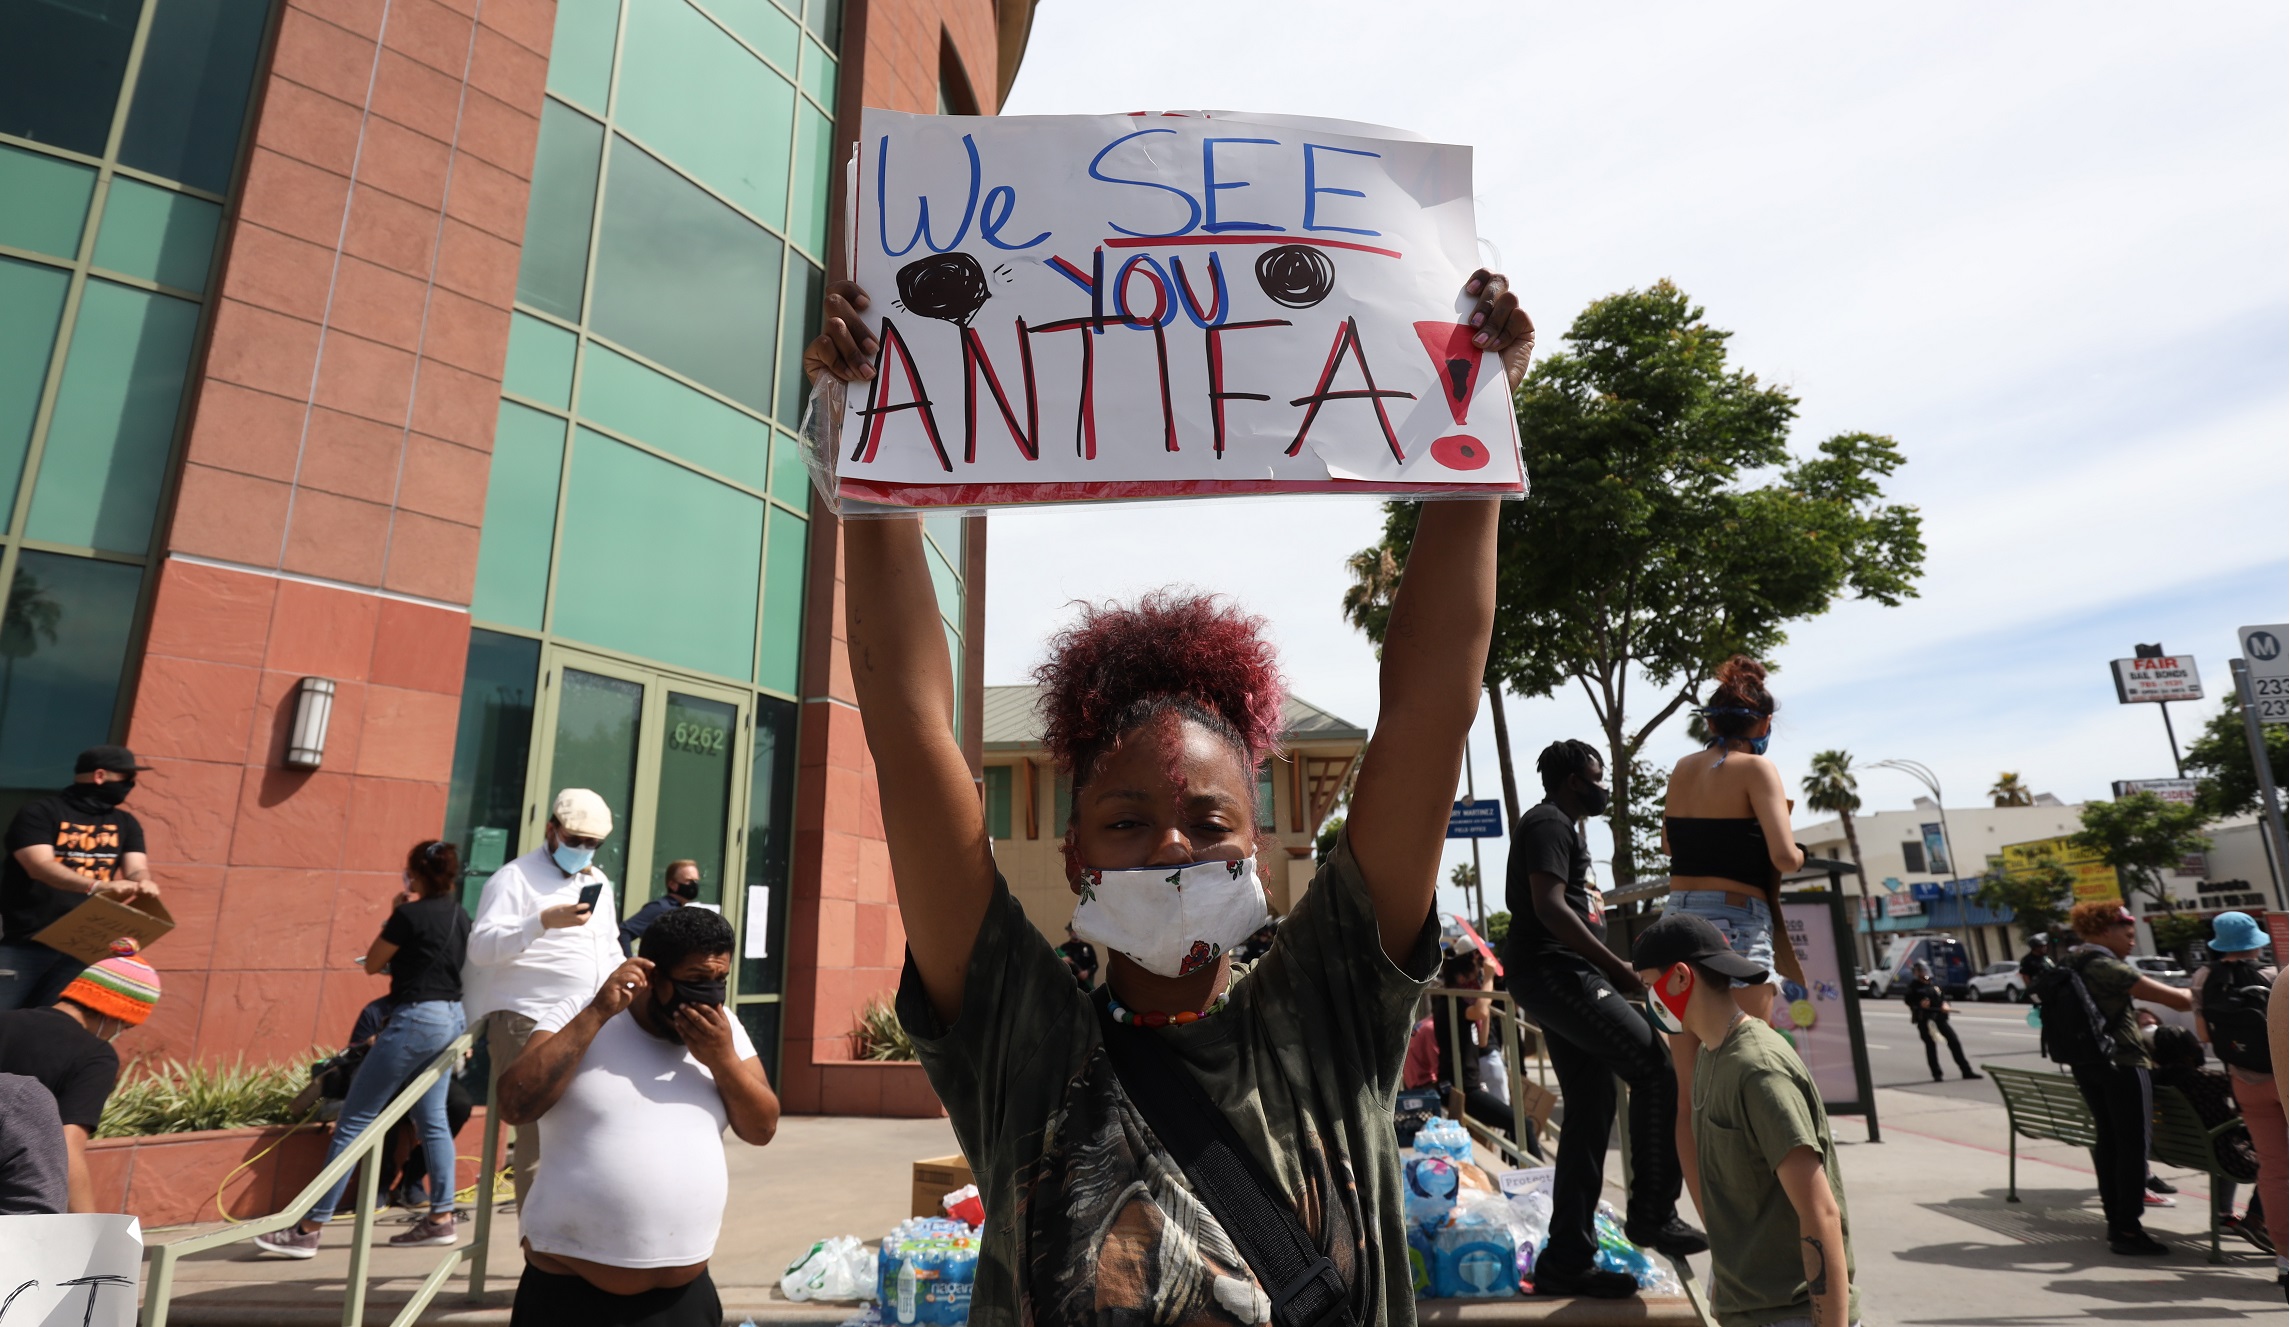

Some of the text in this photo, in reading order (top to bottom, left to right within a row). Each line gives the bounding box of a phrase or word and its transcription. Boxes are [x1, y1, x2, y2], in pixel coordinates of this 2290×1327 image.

[877, 128, 1384, 258] We SEE
[1043, 246, 1230, 333] YOU
[851, 315, 1491, 472] ANTIFA!
[2133, 657, 2179, 670] FAIR
[675, 722, 723, 749] 6262
[2261, 700, 2288, 716] 23
